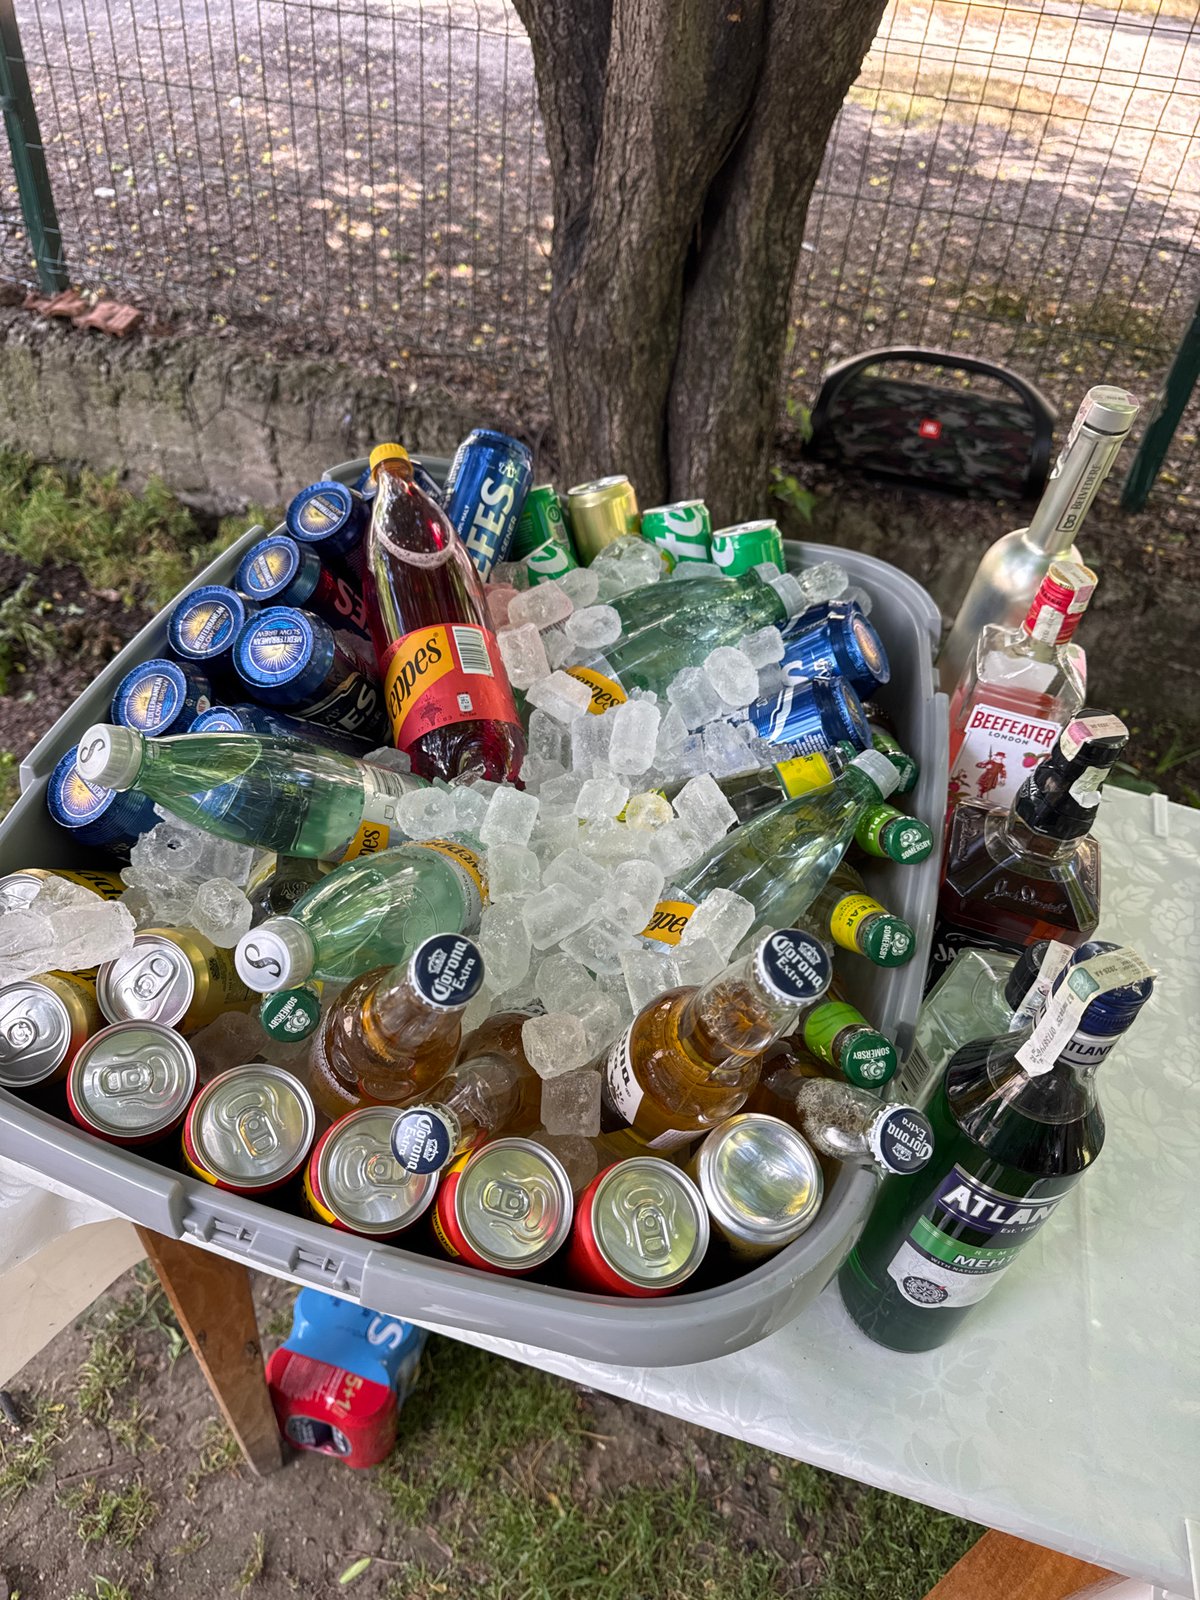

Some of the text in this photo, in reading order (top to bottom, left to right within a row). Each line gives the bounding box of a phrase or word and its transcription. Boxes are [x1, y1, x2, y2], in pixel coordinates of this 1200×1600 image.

[497, 515, 518, 565] ILSENER
[193, 605, 226, 650] MEDITERRANEAN
[253, 635, 303, 646] MEDITERRANEAN
[256, 628, 301, 638] SLOW BREW
[145, 677, 164, 728] MEDITERRANEAN
[970, 710, 1057, 748] BEEFEATER
[988, 731, 1030, 745] LONDON
[901, 839, 931, 860] SOMERSBY
[846, 903, 877, 928] PEAR
[878, 925, 892, 960] SOMERSBY
[431, 940, 468, 1001] Corona
[451, 958, 476, 991] Extra
[772, 934, 824, 990] Corona
[775, 956, 804, 989] Extra
[267, 996, 298, 1030] SOMERSBY
[852, 1046, 890, 1060] SOMERSBY
[398, 1126, 416, 1156] Extra
[406, 1114, 433, 1170] Corona
[887, 1121, 934, 1160] Corona
[902, 1117, 927, 1141] Extra
[930, 1256, 953, 1269] WITH
